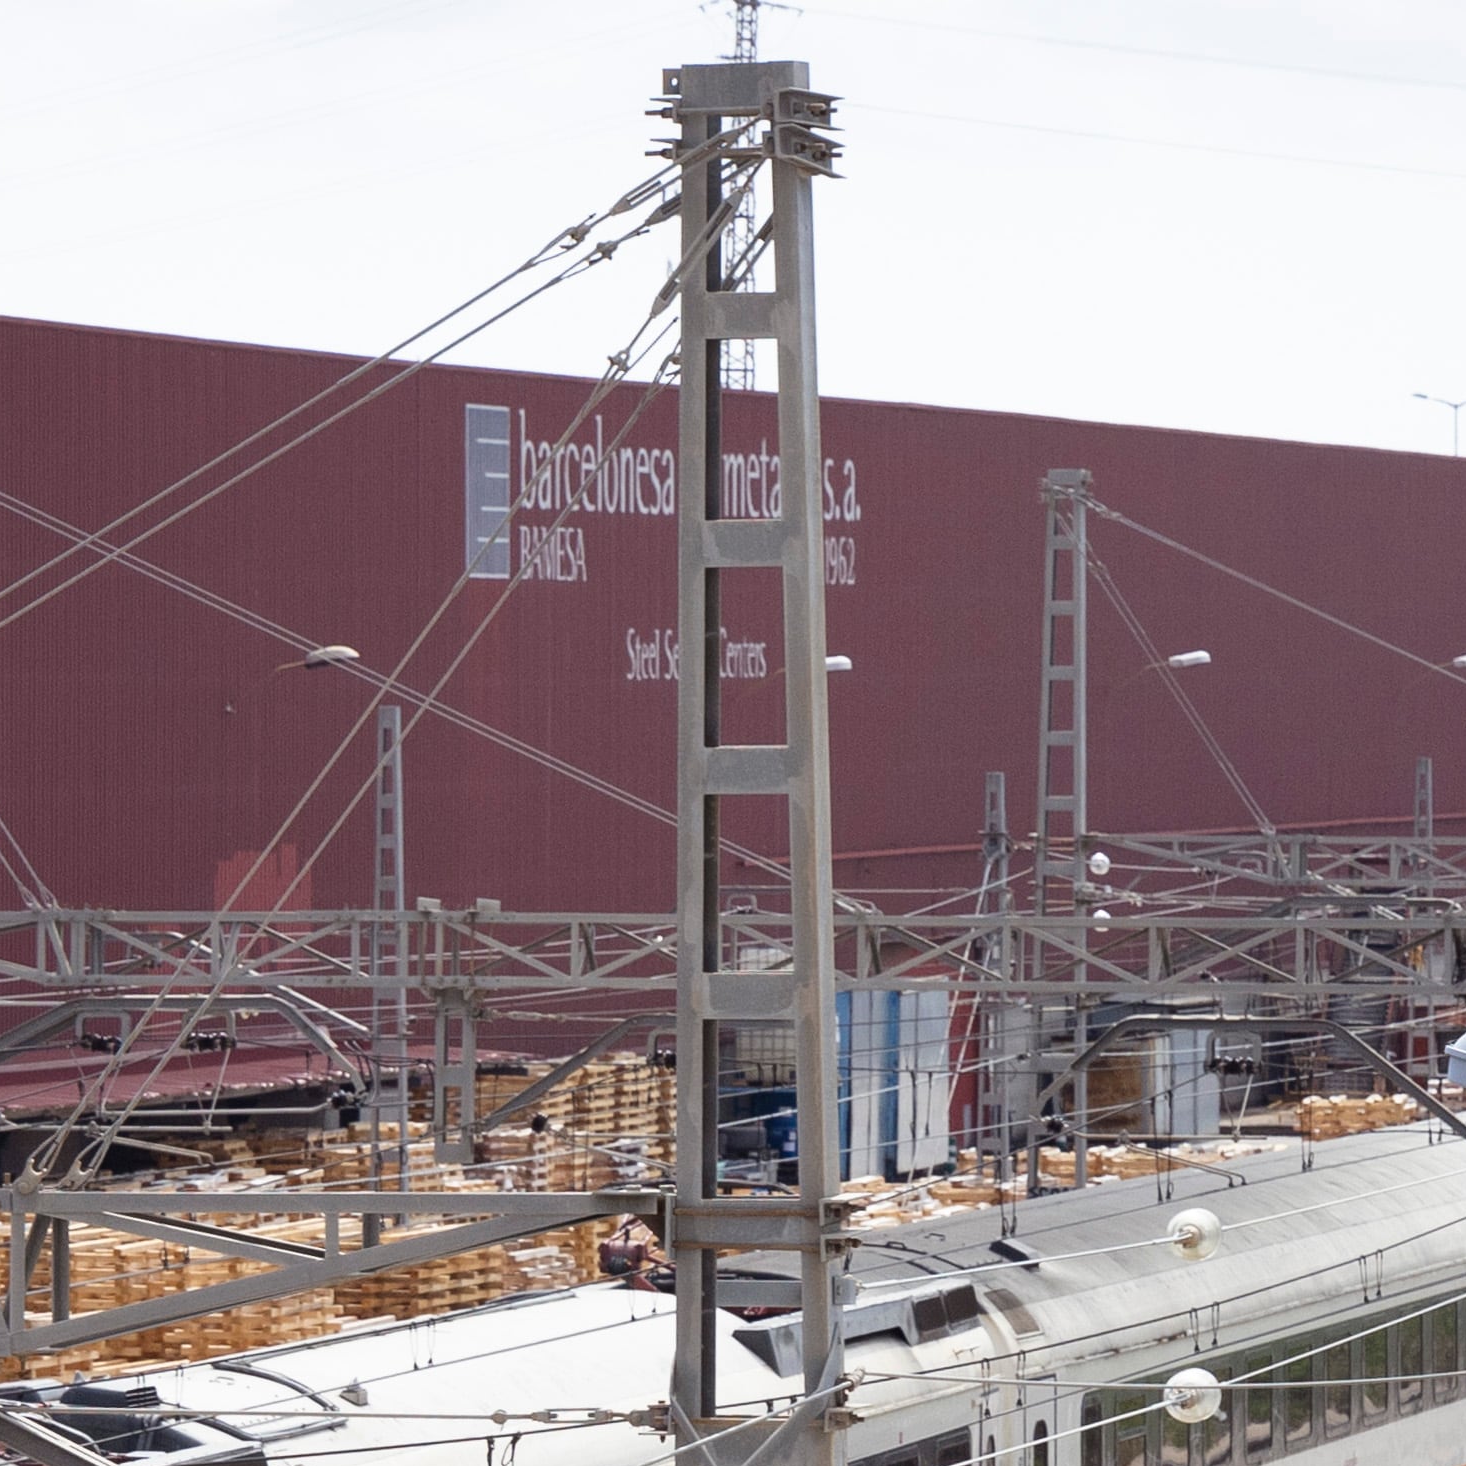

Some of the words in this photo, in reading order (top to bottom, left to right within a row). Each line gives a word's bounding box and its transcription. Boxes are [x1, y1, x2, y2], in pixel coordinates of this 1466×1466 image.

[519, 409, 675, 516] barcelonesa
[723, 437, 781, 518] meta
[824, 458, 861, 521] s.a.
[520, 525, 587, 582] BAMESA
[825, 537, 855, 585] 1962
[627, 628, 660, 680] Steel
[720, 627, 766, 678] Centers
